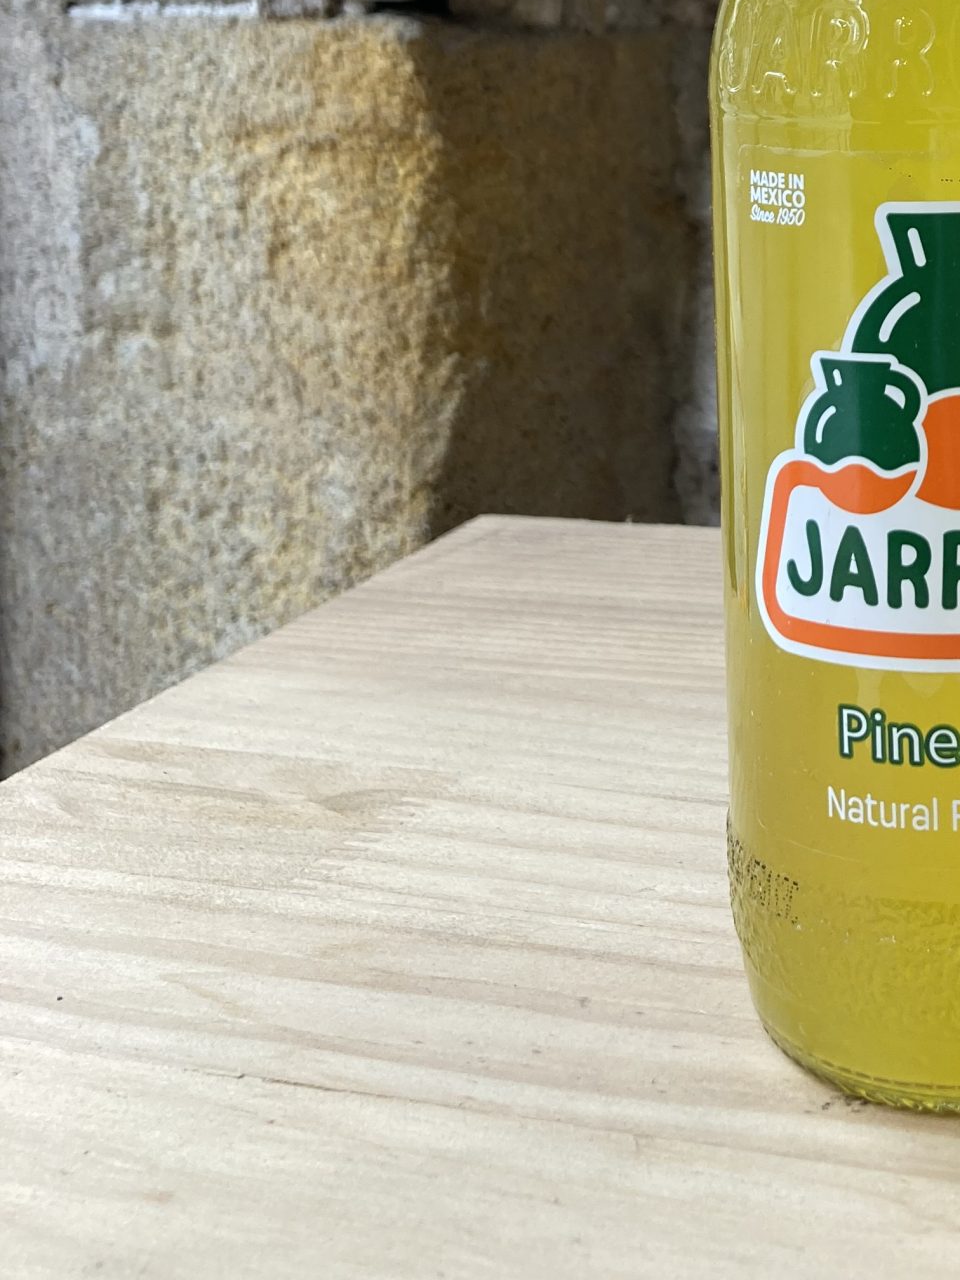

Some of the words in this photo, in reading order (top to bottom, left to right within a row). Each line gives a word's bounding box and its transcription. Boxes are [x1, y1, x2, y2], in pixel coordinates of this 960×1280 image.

[750, 169, 785, 189] MADE
[788, 173, 804, 190] IN
[750, 185, 806, 208] MEXICO
[750, 204, 775, 224] Since
[776, 208, 805, 226] 1950
[826, 785, 939, 832] Natural
